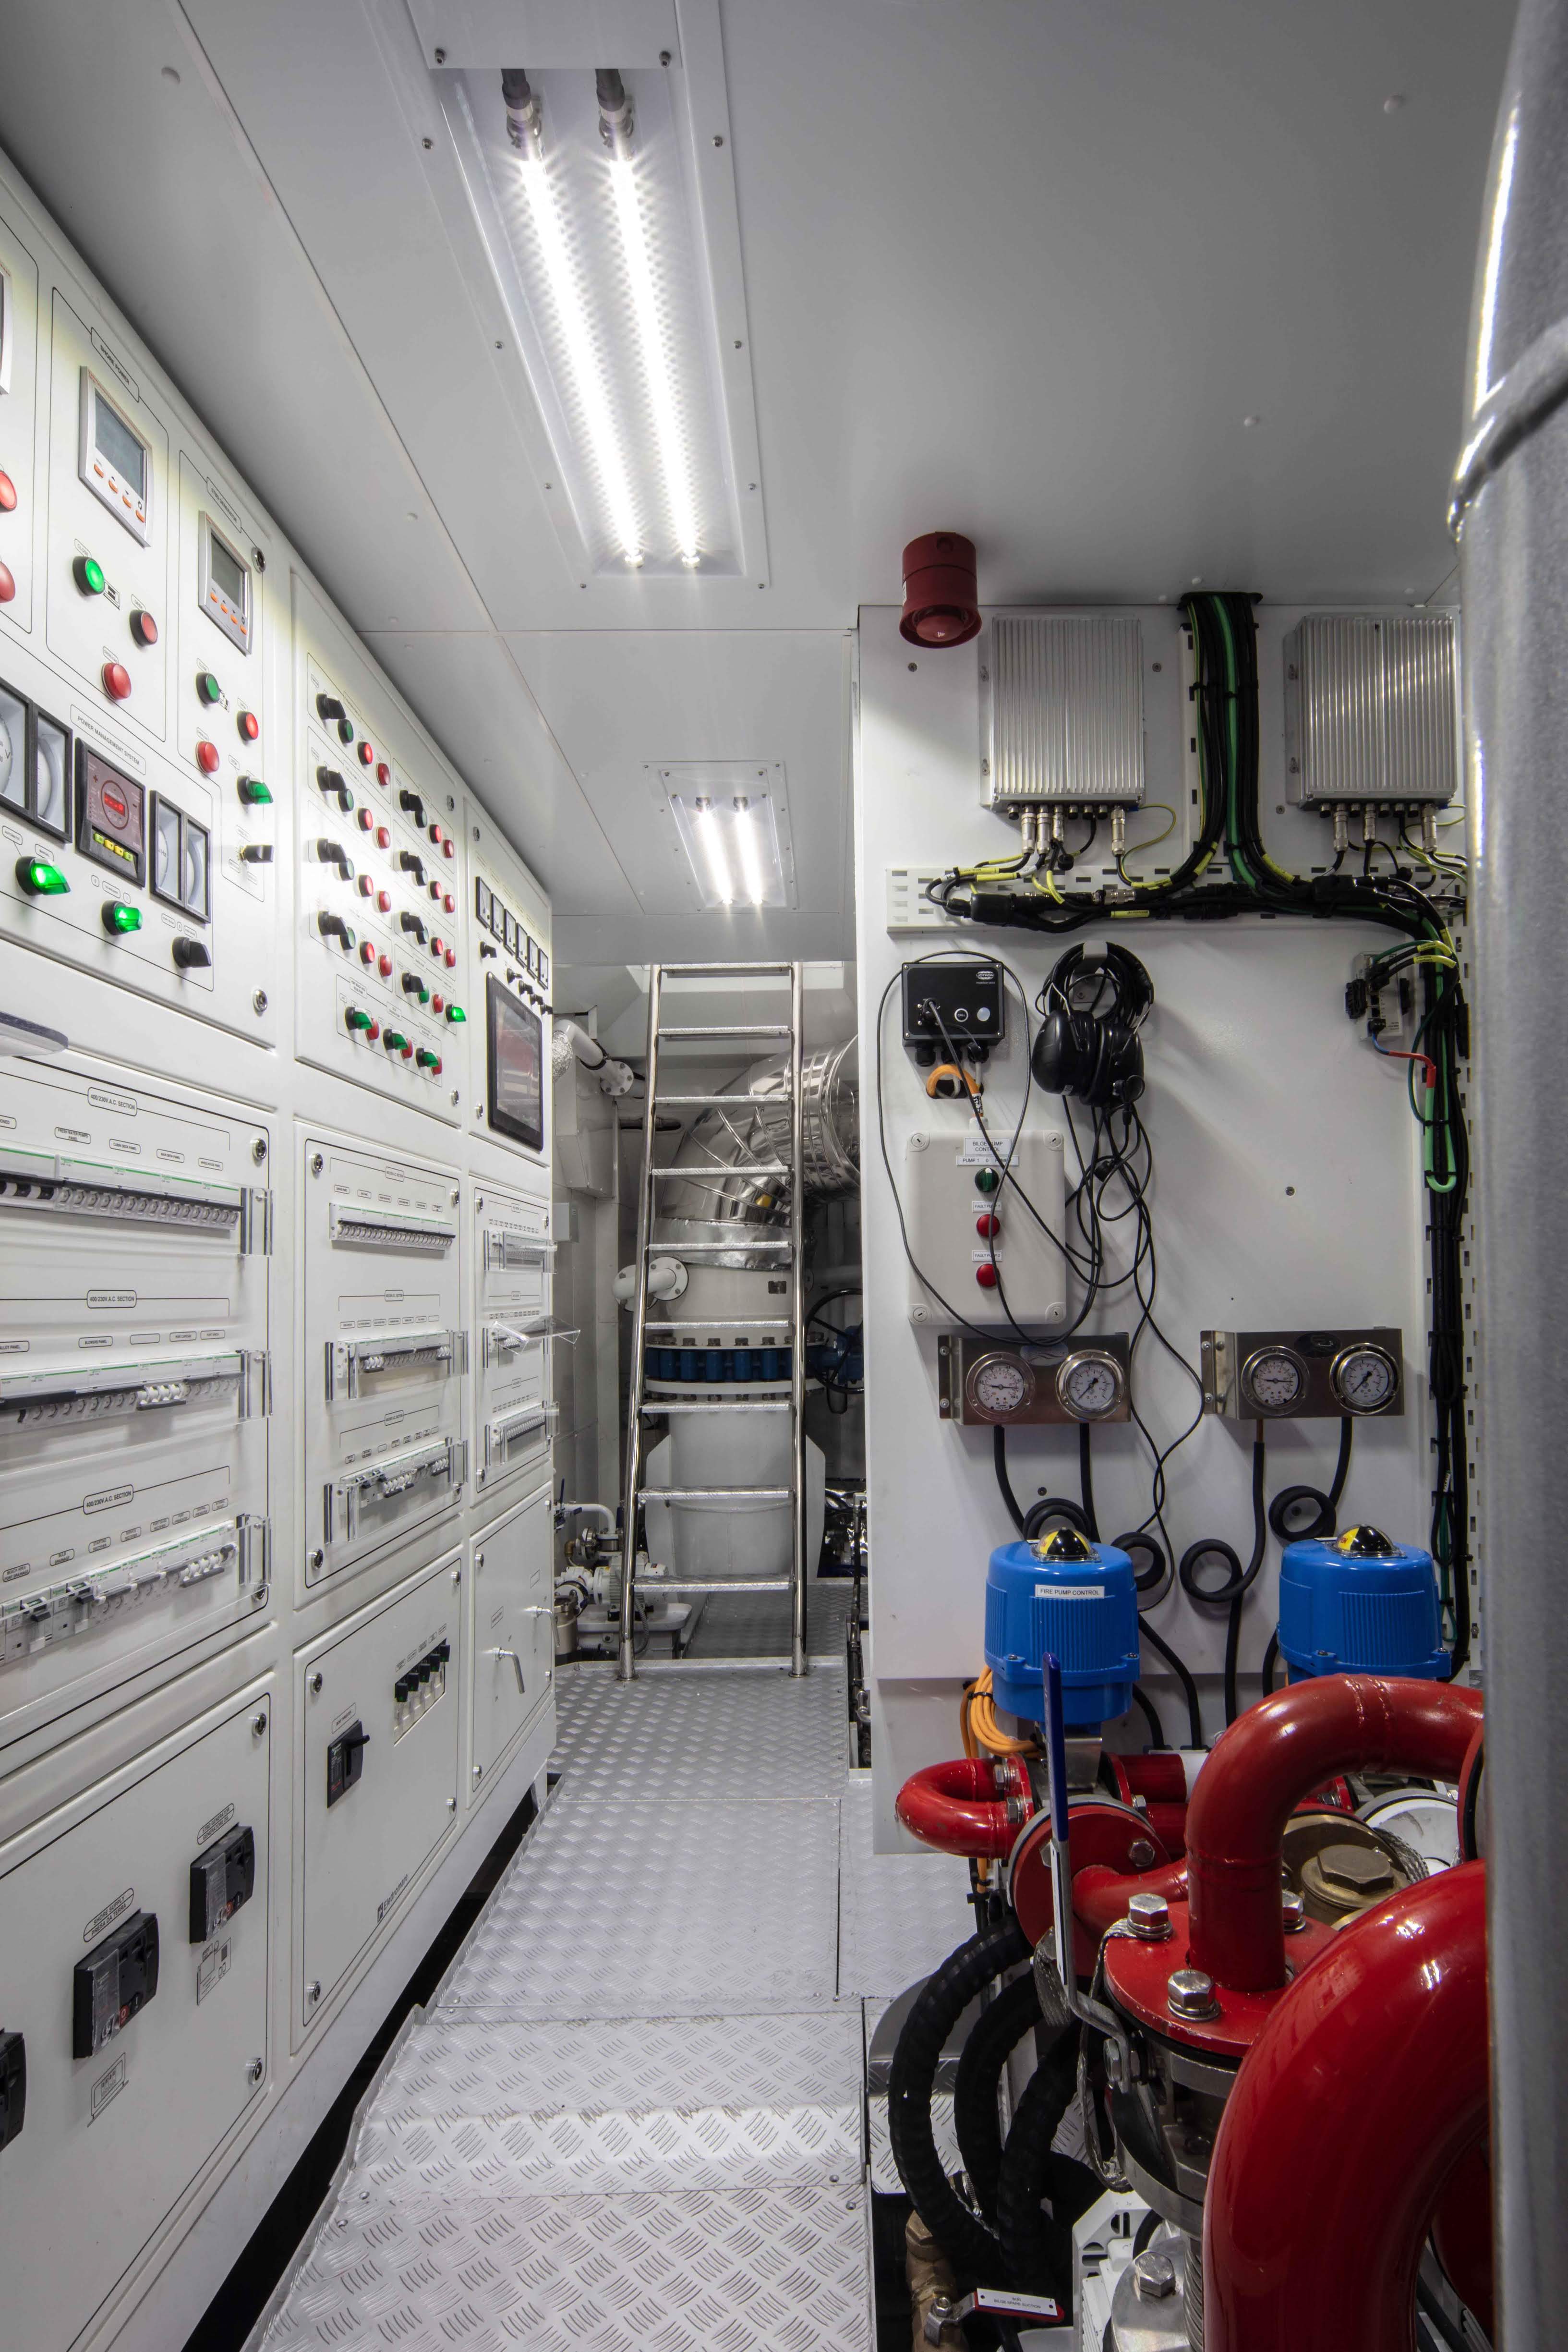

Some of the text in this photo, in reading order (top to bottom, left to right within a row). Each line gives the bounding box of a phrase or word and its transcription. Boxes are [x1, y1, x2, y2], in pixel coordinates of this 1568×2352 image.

[100, 344, 130, 386] SHORE POWER
[78, 715, 140, 765] POWER MANAGEMENT SYSTEM
[5, 749, 11, 759] V
[4, 830, 20, 840] AUTOMATIC
[161, 848, 167, 857] Hz
[118, 1101, 135, 1110] SECTION
[114, 1491, 132, 1501] SECTION
[93, 1543, 107, 1551] RECTIFIER
[54, 1555, 70, 1564] DRAINAGE
[13, 1570, 29, 1578] DRAINAGE
[211, 1807, 230, 1825] GENERATOR
[203, 1819, 224, 1840] GENERATORE
[384, 1873, 408, 1911] Elettromare
[93, 1895, 125, 1926] SHORE SUPPLY
[91, 1903, 126, 1936] PRESA DA TERRA
